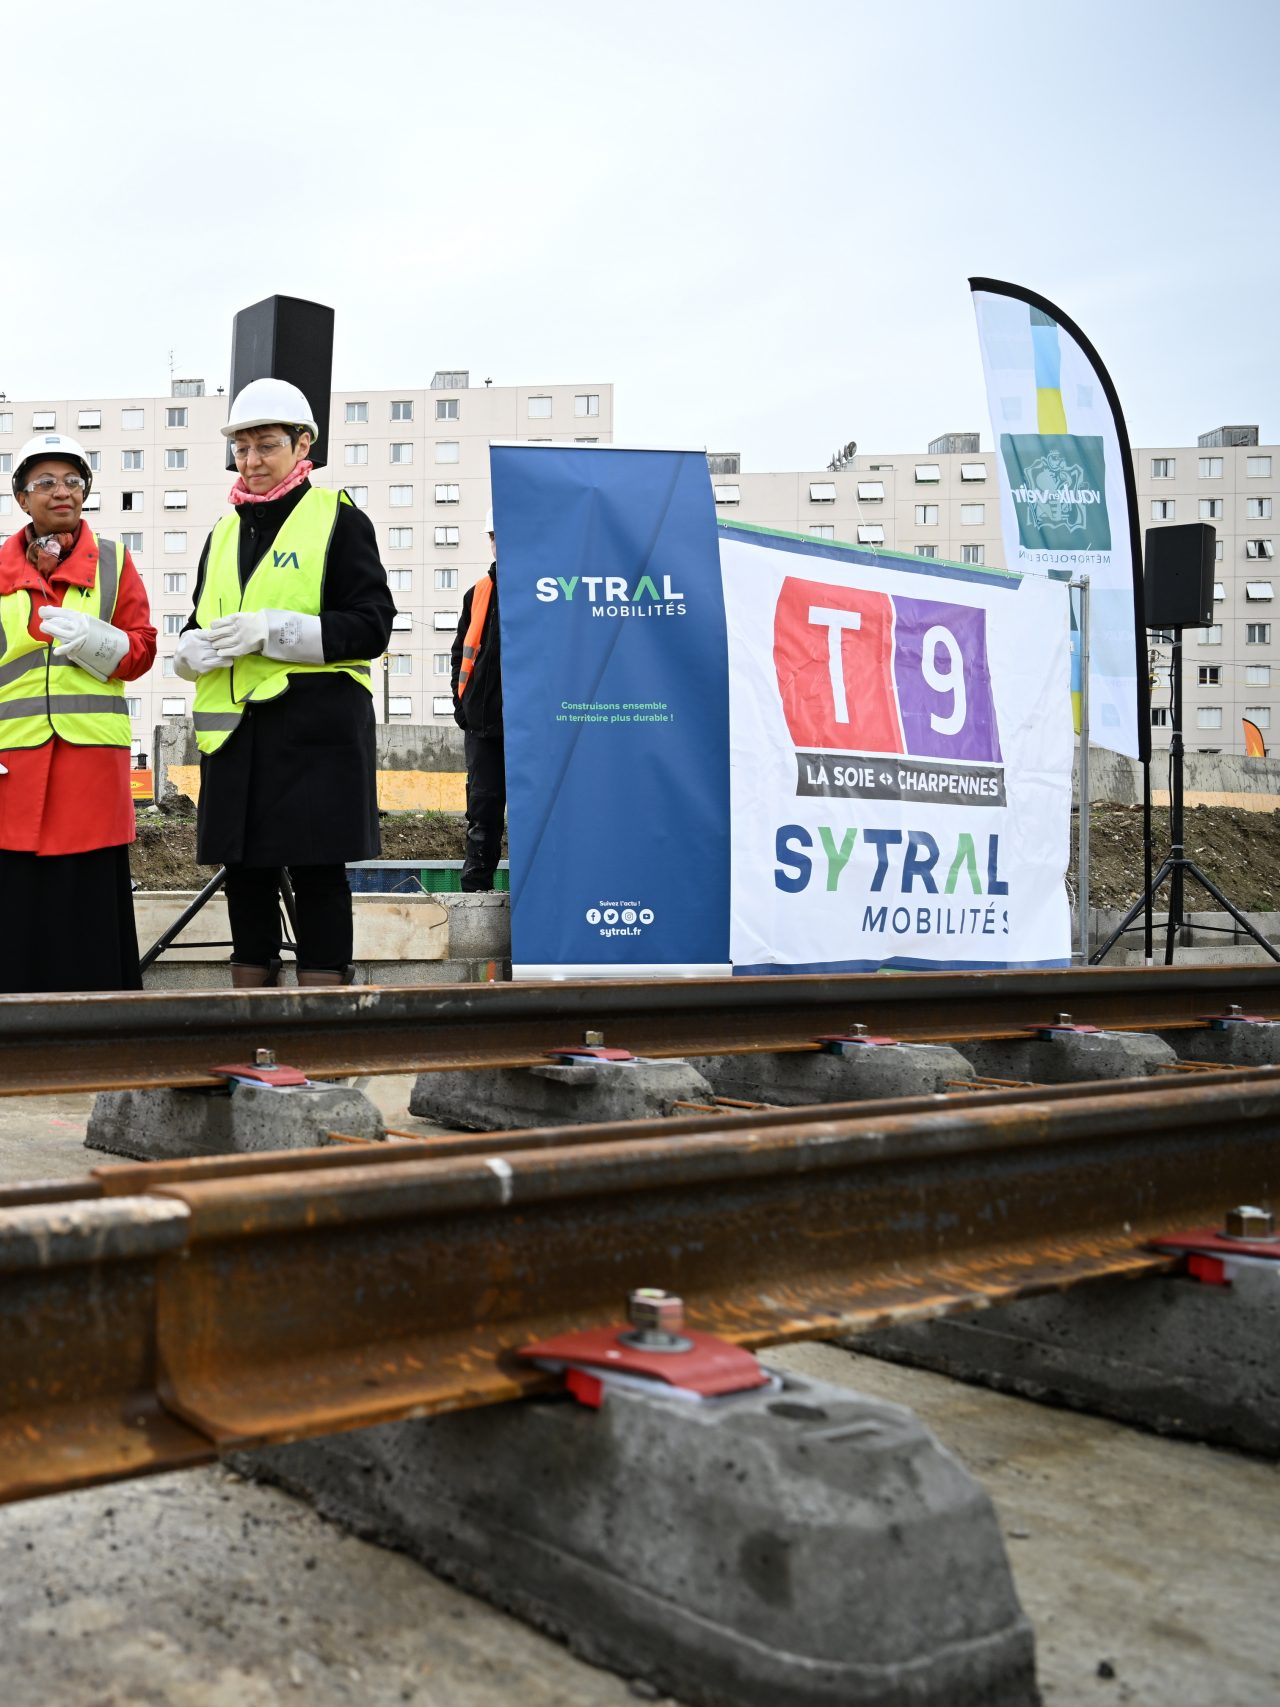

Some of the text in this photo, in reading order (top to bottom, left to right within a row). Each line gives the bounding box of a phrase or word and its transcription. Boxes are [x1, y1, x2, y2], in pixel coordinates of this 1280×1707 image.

[536, 575, 684, 602] SYTRAL
[592, 602, 687, 617] MOBILITÉS
[561, 701, 667, 710] Construisons ensemble
[569, 713, 609, 722] territoire
[611, 713, 631, 724] plus
[806, 765, 999, 796] LA SOIE CHARPENNES
[774, 824, 1009, 896] SYTRAL
[600, 927, 641, 937] sytral.fr
